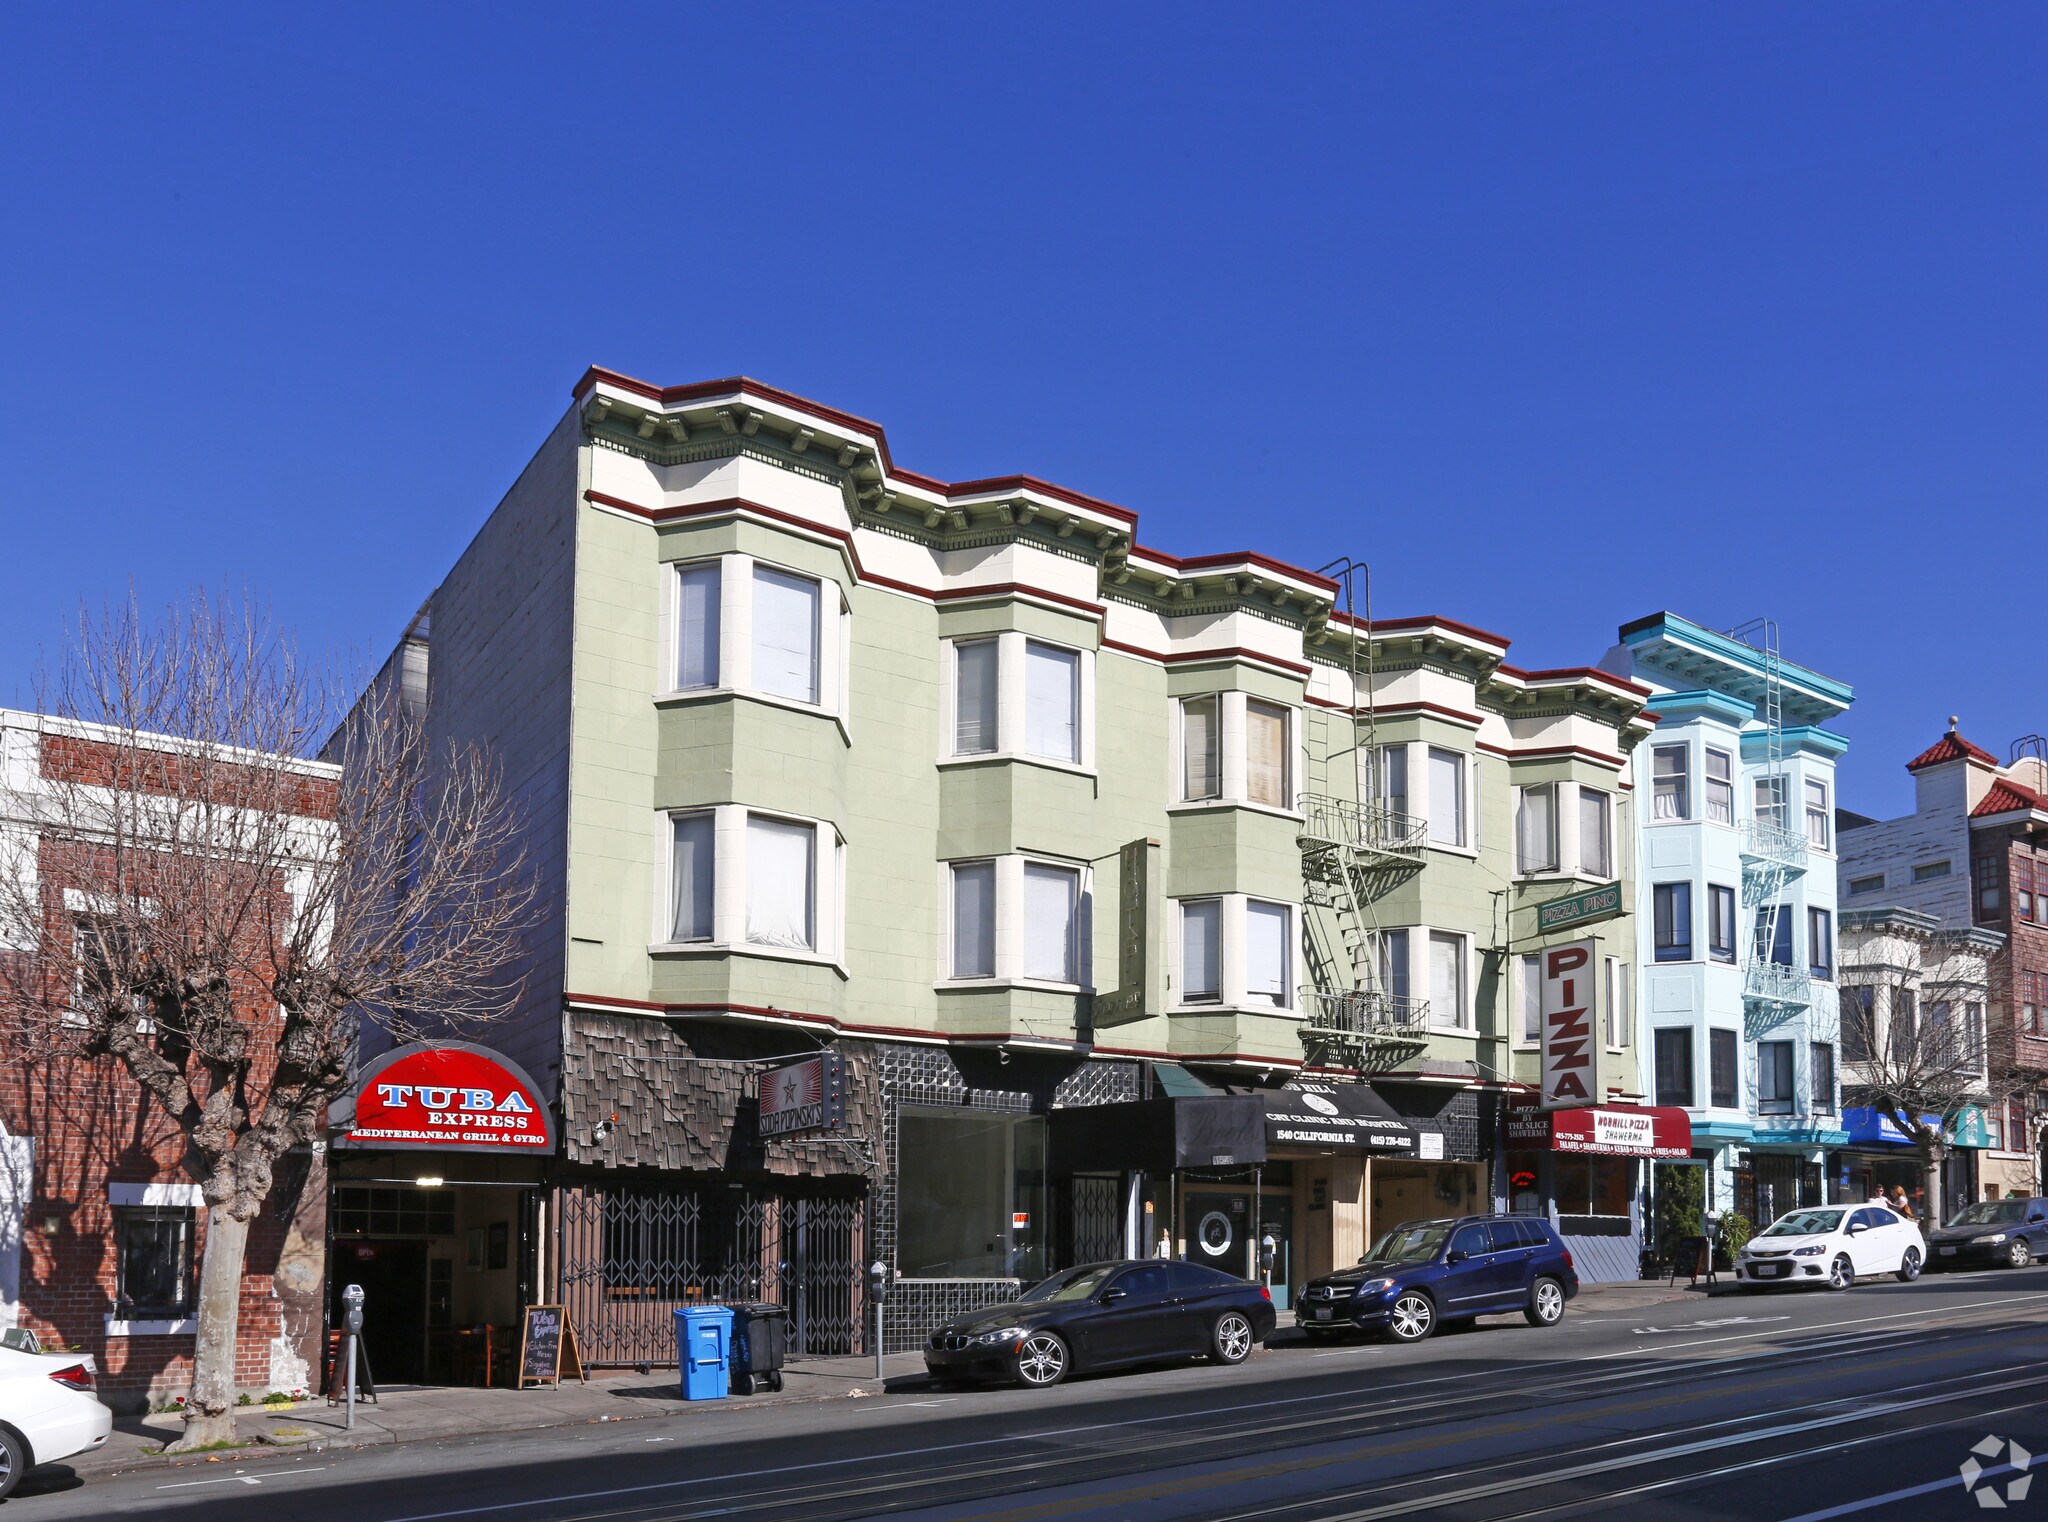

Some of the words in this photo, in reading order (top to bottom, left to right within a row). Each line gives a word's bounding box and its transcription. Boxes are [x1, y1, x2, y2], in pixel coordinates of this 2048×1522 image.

[1542, 902, 1580, 923] PIZZA
[1583, 891, 1617, 912] PINO
[1548, 947, 1590, 1100] PIZZA
[1300, 1084, 1337, 1095] HILL
[377, 1084, 534, 1113] TUBA
[427, 1111, 529, 1129] EXPRESS
[760, 1111, 780, 1134] SODA
[1265, 1113, 1290, 1122] CAT
[1290, 1115, 1331, 1125] CLINIC
[1330, 1117, 1358, 1126] AND
[1354, 1119, 1408, 1130] HOSPITAL
[1522, 1114, 1533, 1122] BY
[1525, 1121, 1548, 1129] SLICE
[1629, 1119, 1650, 1131] PIZZA
[351, 1128, 460, 1141] MEDITERRANEAN
[462, 1132, 499, 1142] GRILL
[501, 1133, 511, 1143] &
[513, 1134, 545, 1144] GYRO
[1277, 1130, 1293, 1140] 1540
[1294, 1131, 1344, 1142] CALIFORNIA
[1345, 1134, 1356, 1143] ST.
[1370, 1135, 1385, 1145] (415)
[1509, 1130, 1547, 1138] SHAWERMA
[1604, 1130, 1643, 1142] SHAWERMA
[1560, 1141, 1580, 1150] FALAFEL
[1583, 1142, 1611, 1152] SHAWERMA
[1633, 1146, 1653, 1154] BURGER
[1671, 1148, 1687, 1156] SALAD
[530, 1310, 555, 1325] Tuba
